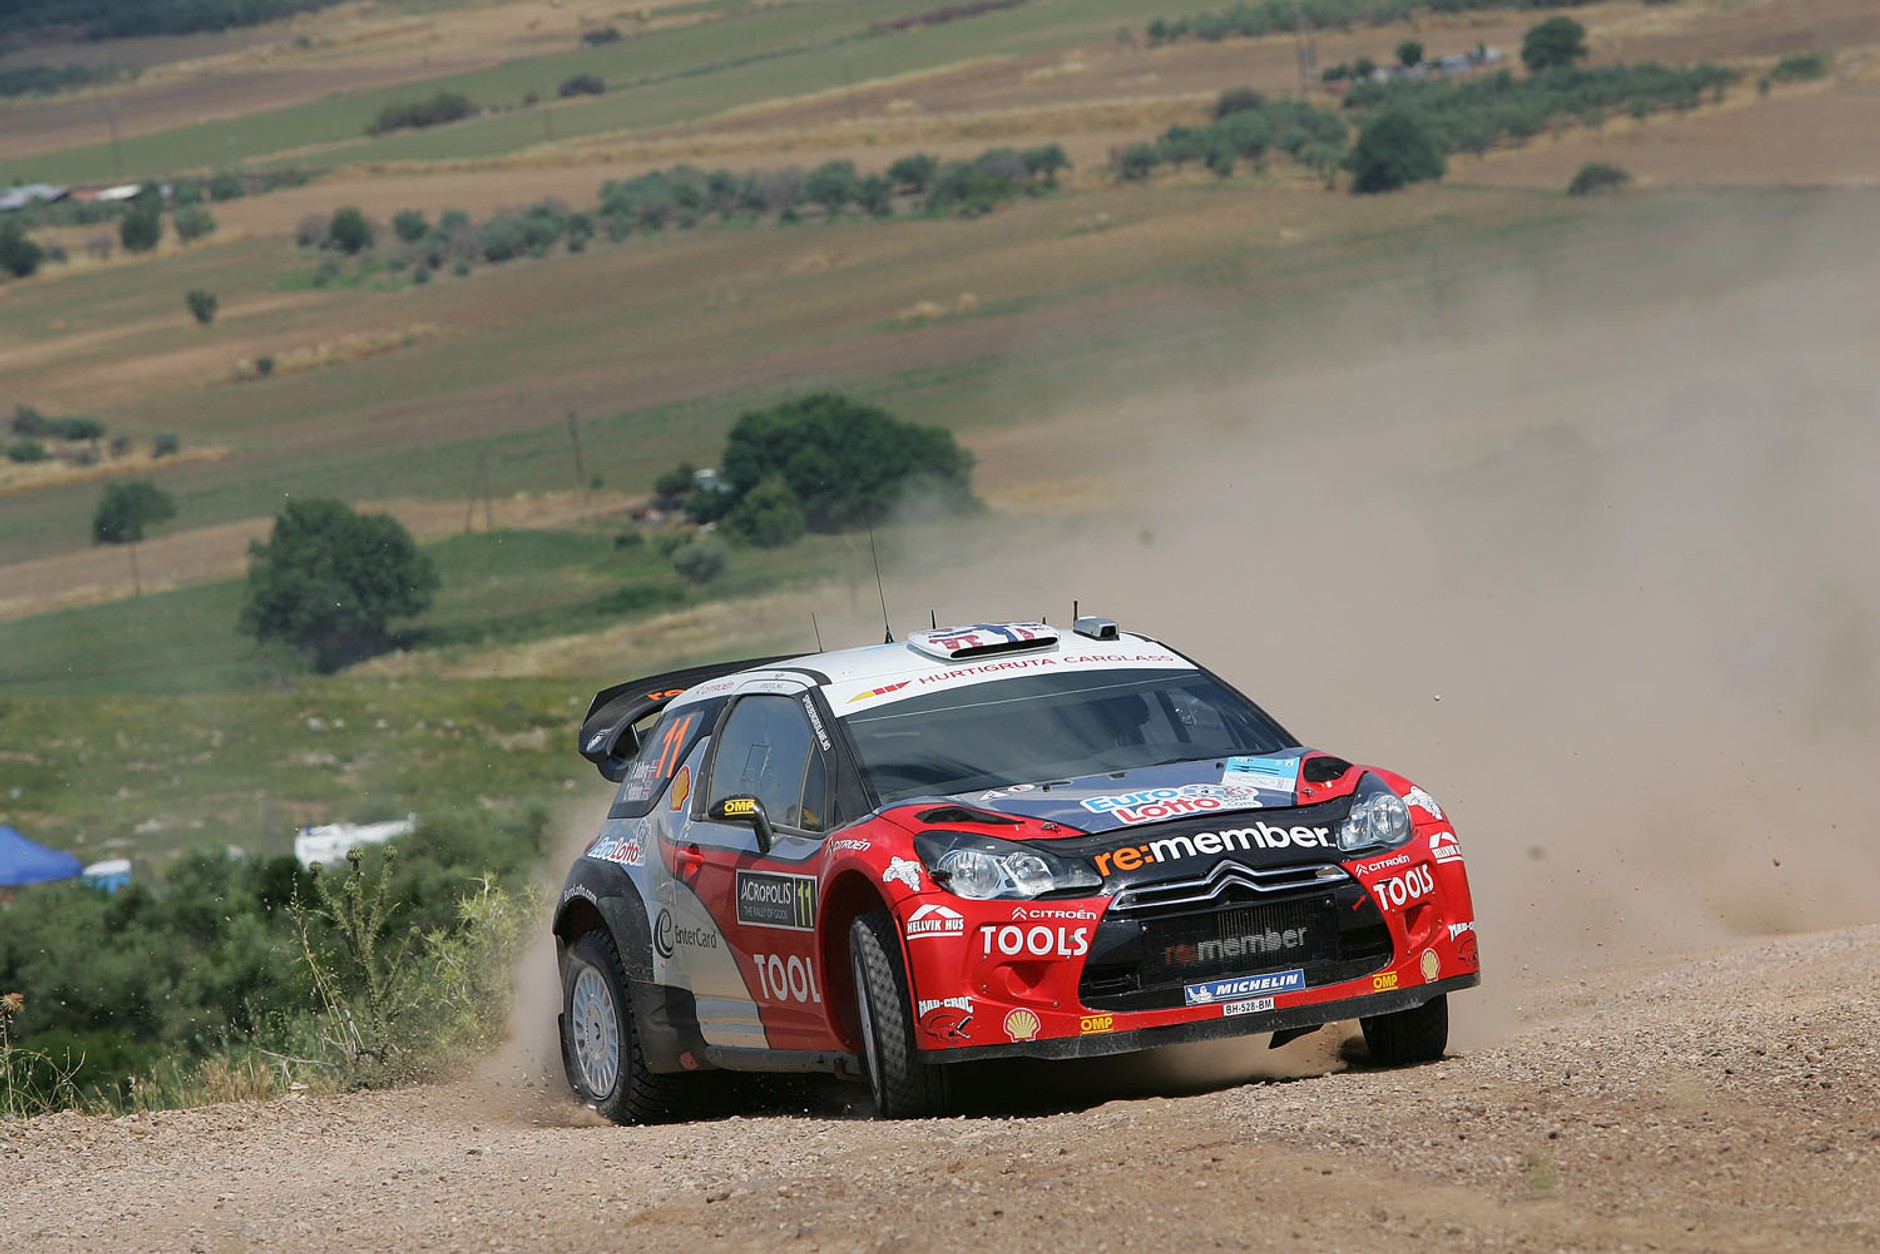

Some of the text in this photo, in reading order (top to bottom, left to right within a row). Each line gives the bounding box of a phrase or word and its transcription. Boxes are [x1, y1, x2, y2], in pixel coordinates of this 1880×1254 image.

[919, 654, 1174, 685] HURTIGRUTA CARGLASS
[655, 716, 692, 778] 11
[724, 801, 756, 811] OMP
[1088, 789, 1178, 811] Euro
[1116, 798, 1221, 823] Lotto
[1094, 821, 1329, 877] re:member
[740, 878, 791, 905] ACROPOLIS
[1373, 863, 1434, 911] TOOLS
[797, 881, 814, 927] 11
[675, 925, 717, 948] EnterCard
[907, 917, 964, 934] HELLVIK HUS
[980, 926, 1089, 956] TOOLS
[1215, 973, 1299, 996] MICHELIN
[1373, 976, 1398, 988] OMP
[918, 996, 974, 1017] MAD-CROC
[1225, 1000, 1273, 1015] BH-528-BM
[1080, 1017, 1113, 1030] OMP
